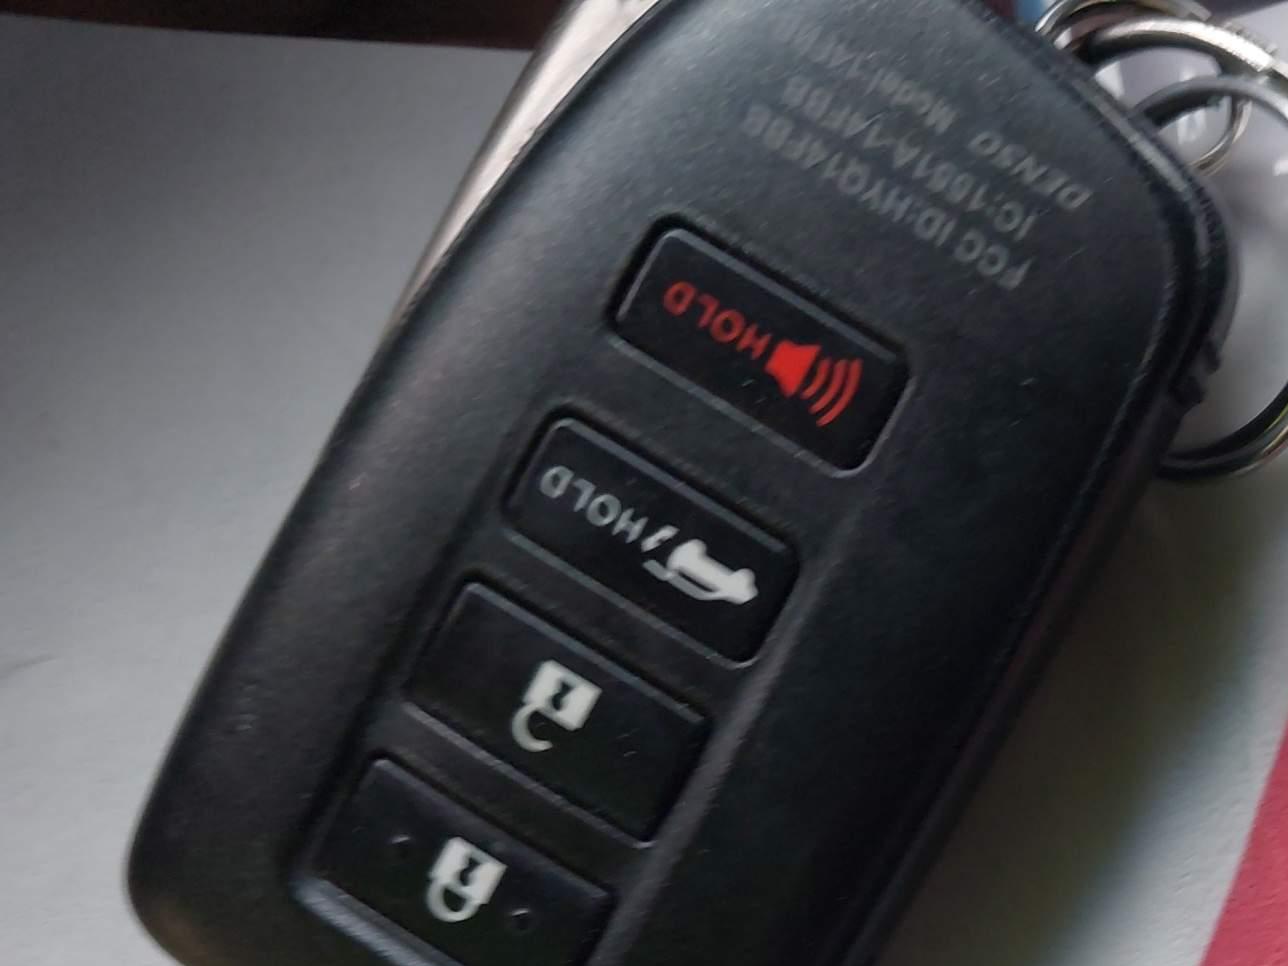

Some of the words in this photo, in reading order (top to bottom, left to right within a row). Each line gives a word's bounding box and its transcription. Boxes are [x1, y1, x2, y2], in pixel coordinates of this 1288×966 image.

[969, 131, 1094, 210] DENSO
[955, 228, 1034, 290] FCC
[664, 281, 772, 360] HOLD
[541, 465, 648, 543] HOLD
